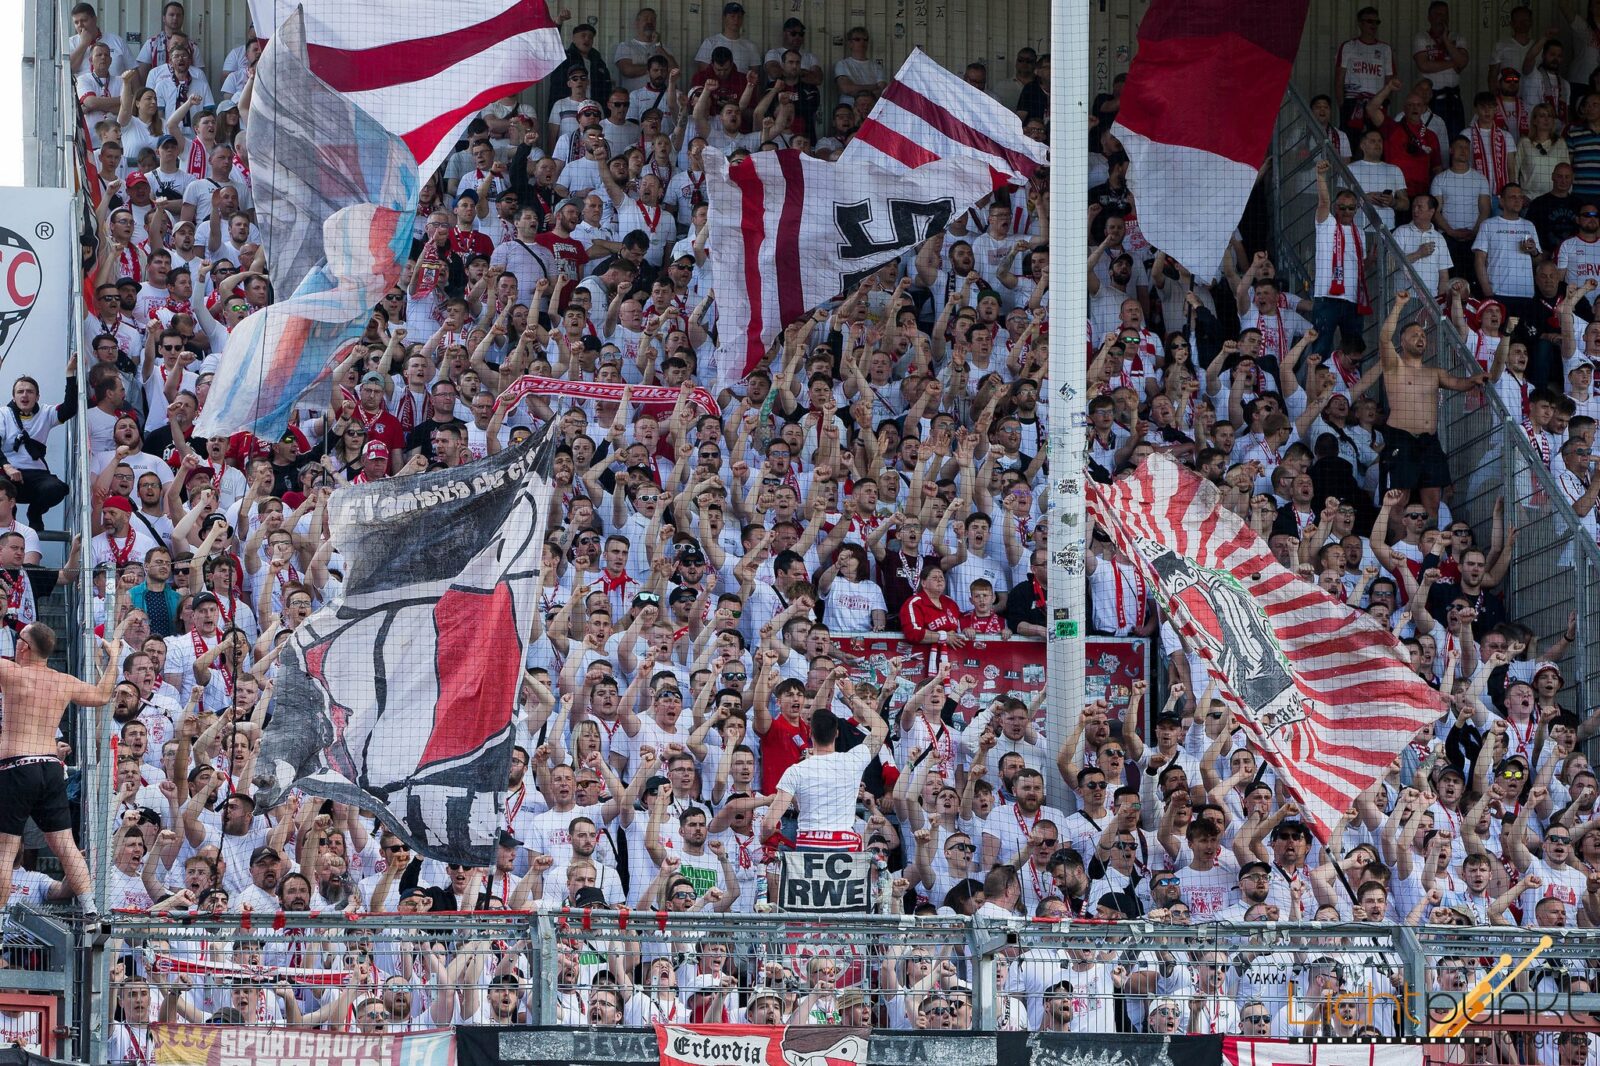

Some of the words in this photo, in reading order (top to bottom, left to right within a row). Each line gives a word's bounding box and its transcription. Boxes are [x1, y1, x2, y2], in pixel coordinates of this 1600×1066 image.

[1361, 62, 1383, 76] RWE
[803, 853, 853, 879] FC
[788, 879, 865, 906] RWE
[220, 1029, 393, 1059] SPORTGRUPPE
[674, 1036, 762, 1064] Erfordia
